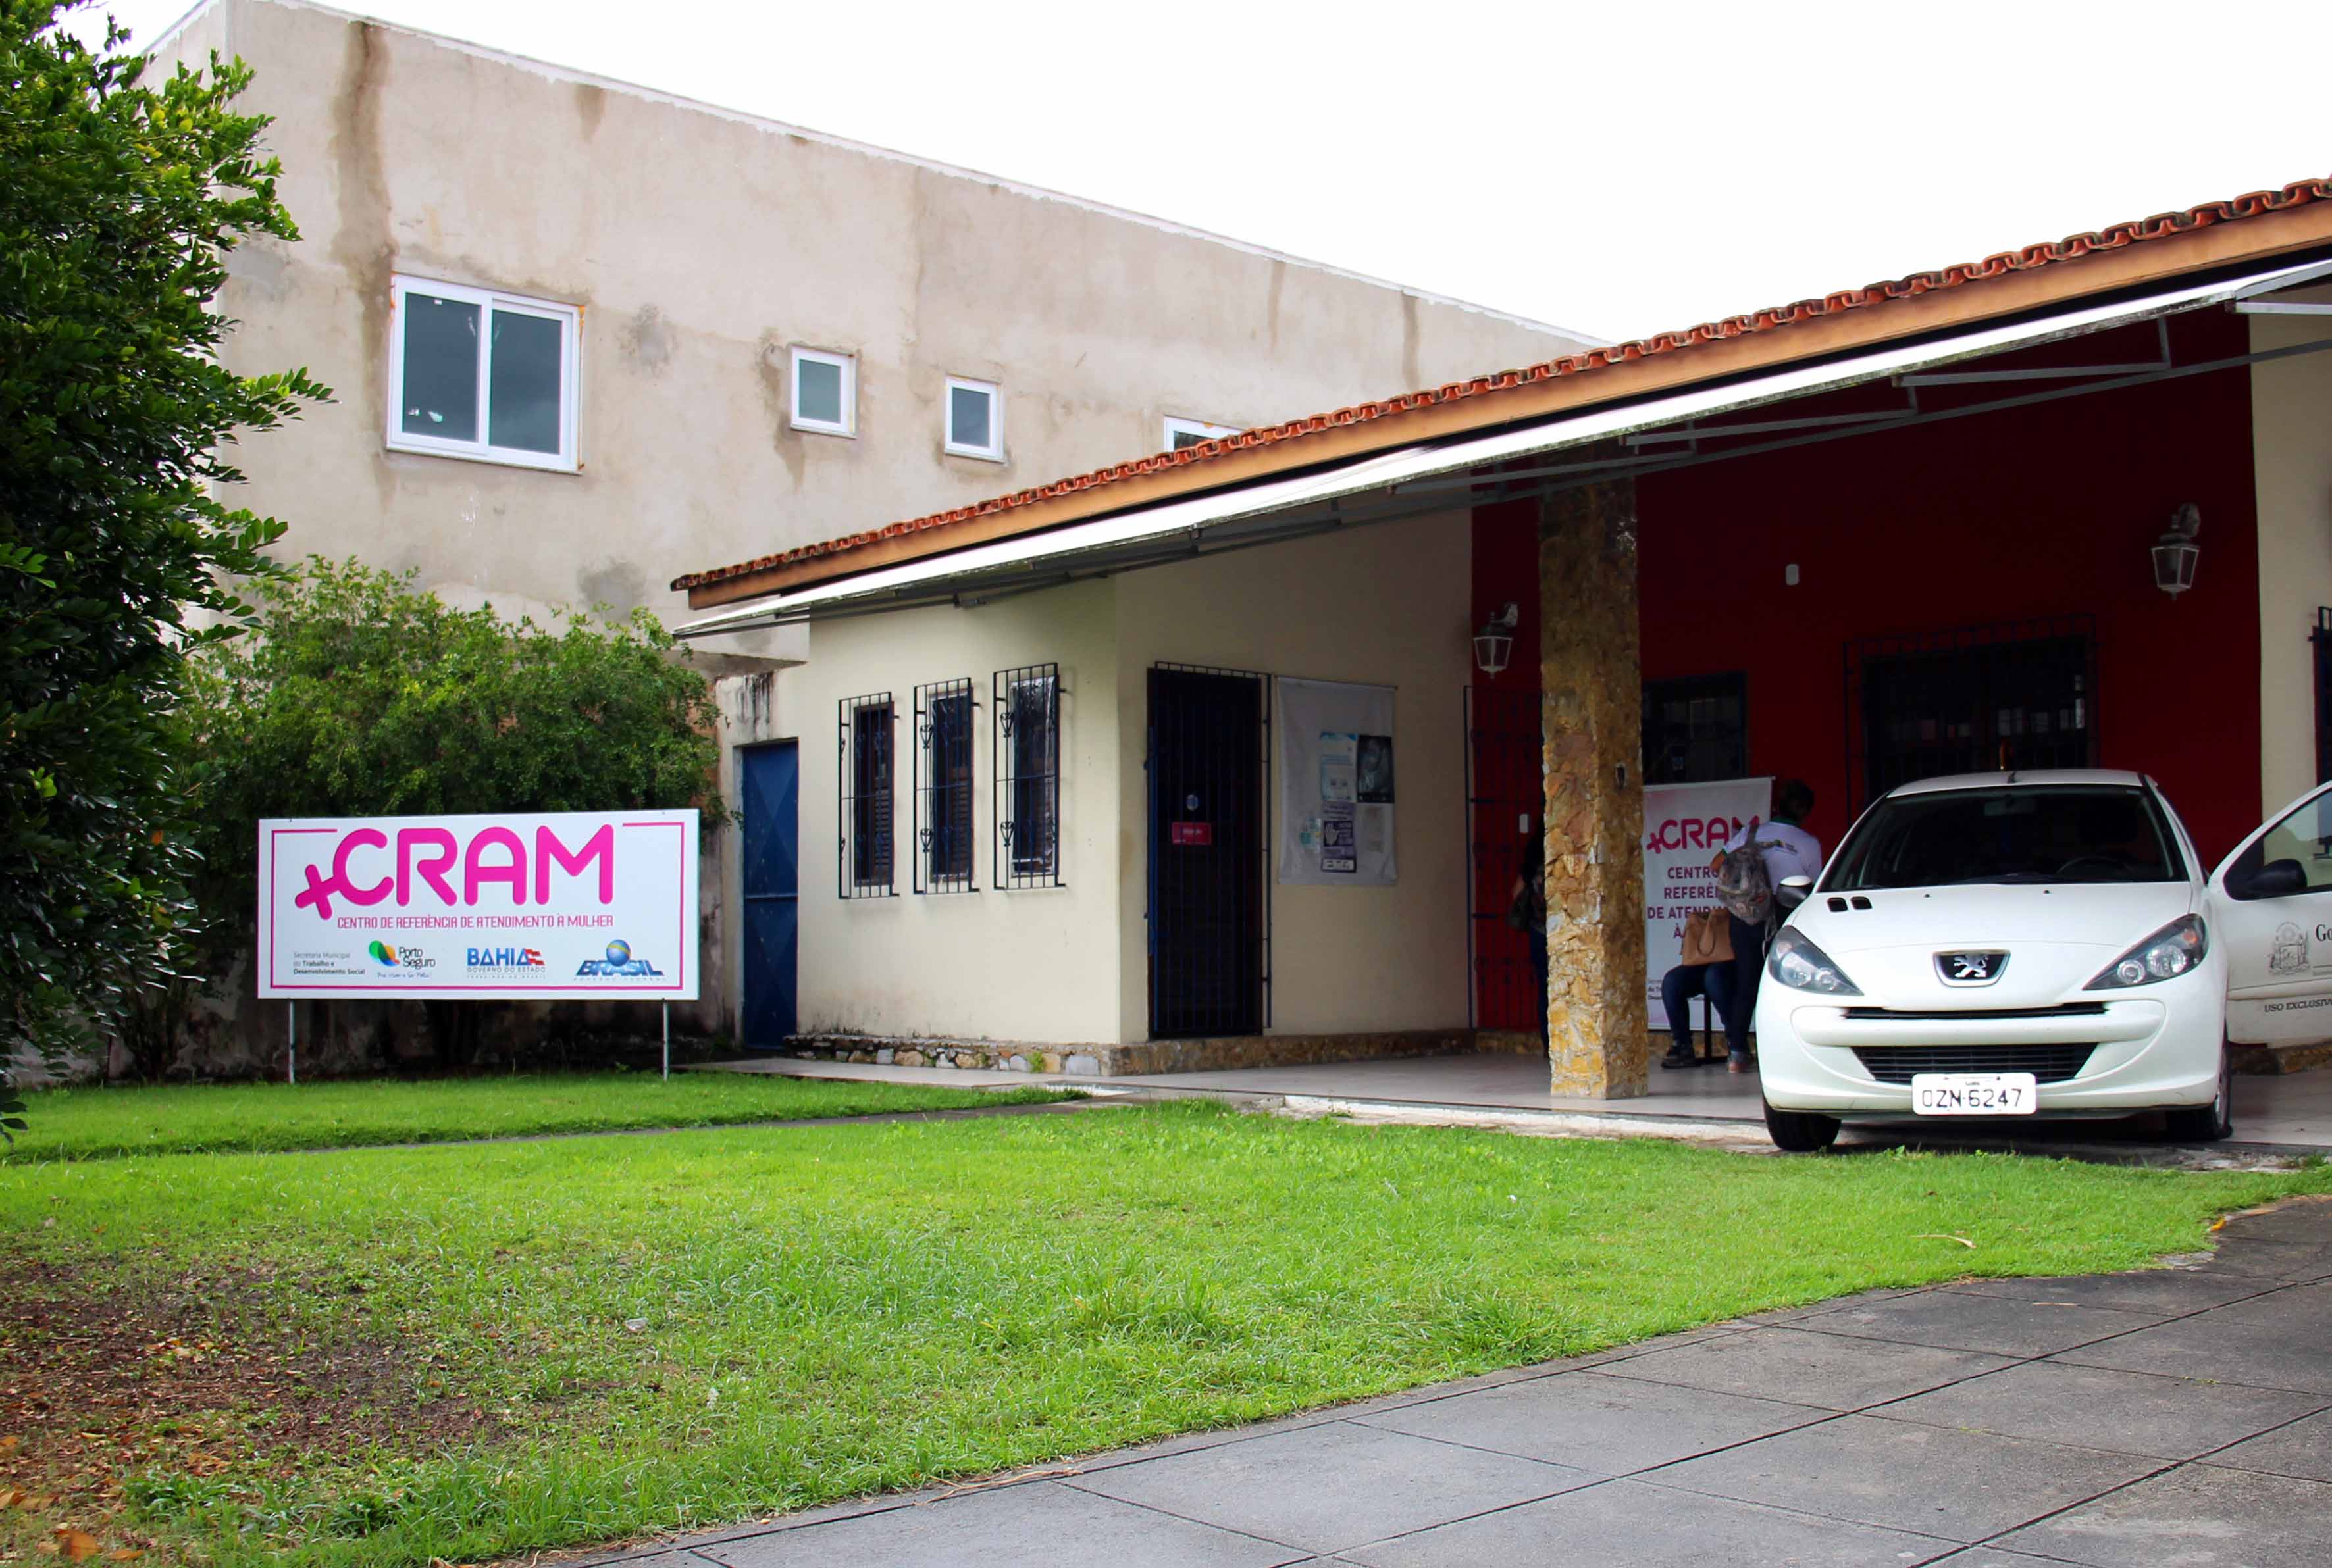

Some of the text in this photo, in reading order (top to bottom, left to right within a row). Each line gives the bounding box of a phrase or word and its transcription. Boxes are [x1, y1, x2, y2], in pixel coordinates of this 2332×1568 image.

[1659, 815, 1759, 850] CRA
[332, 824, 614, 907] CRAM
[1664, 882, 1719, 899] REFERÊ
[1647, 906, 1665, 919] DE
[337, 917, 378, 928] CENTRO
[381, 917, 394, 928] DE
[396, 913, 457, 928] REFERÊNCIA
[461, 916, 474, 928] DE
[477, 915, 554, 928] ATENDIMENTO
[568, 915, 613, 927] MULHER
[398, 946, 423, 958] Porto
[467, 947, 532, 966] BAHIA
[403, 958, 436, 970] Seguro
[2264, 1003, 2284, 1013] USO
